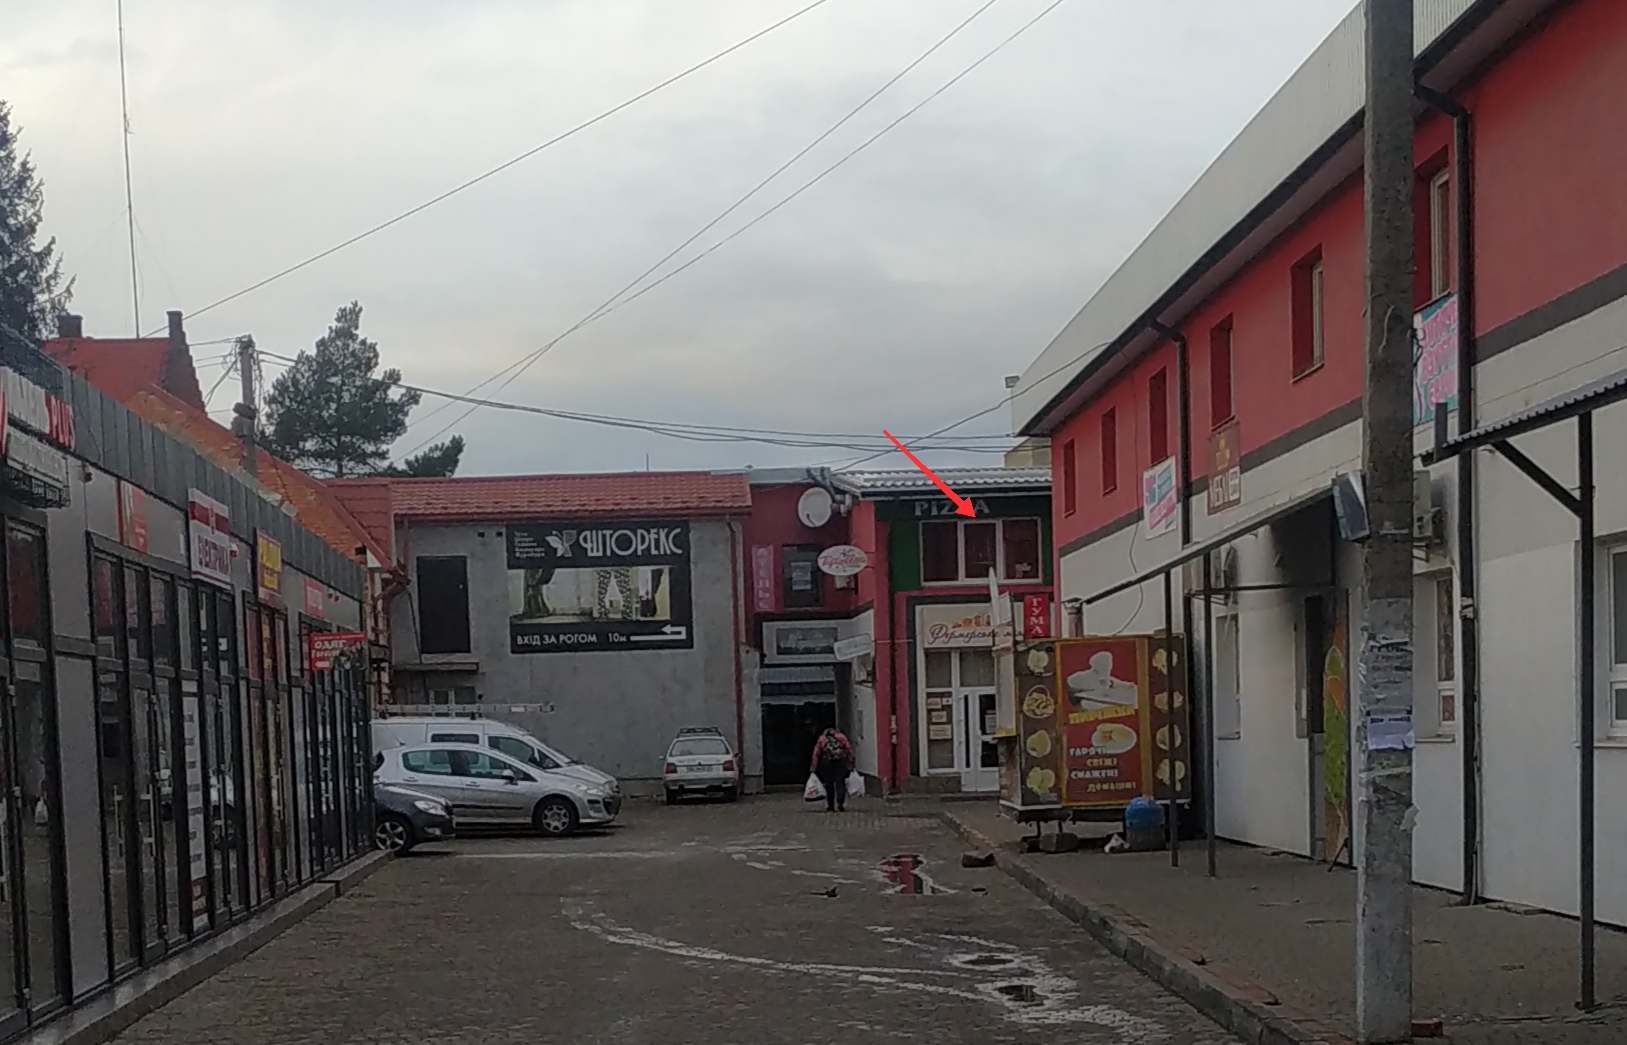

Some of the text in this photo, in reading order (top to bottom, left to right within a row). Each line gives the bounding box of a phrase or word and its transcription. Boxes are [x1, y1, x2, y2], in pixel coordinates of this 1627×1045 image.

[50, 394, 76, 451] PLUS
[914, 499, 990, 516] PIZA
[578, 528, 684, 557] ШТОРЕКС
[1029, 597, 1045, 637] ГУМА
[517, 634, 541, 645] ВХІД
[542, 634, 557, 645] ЗА
[559, 633, 597, 644] РОГОМ
